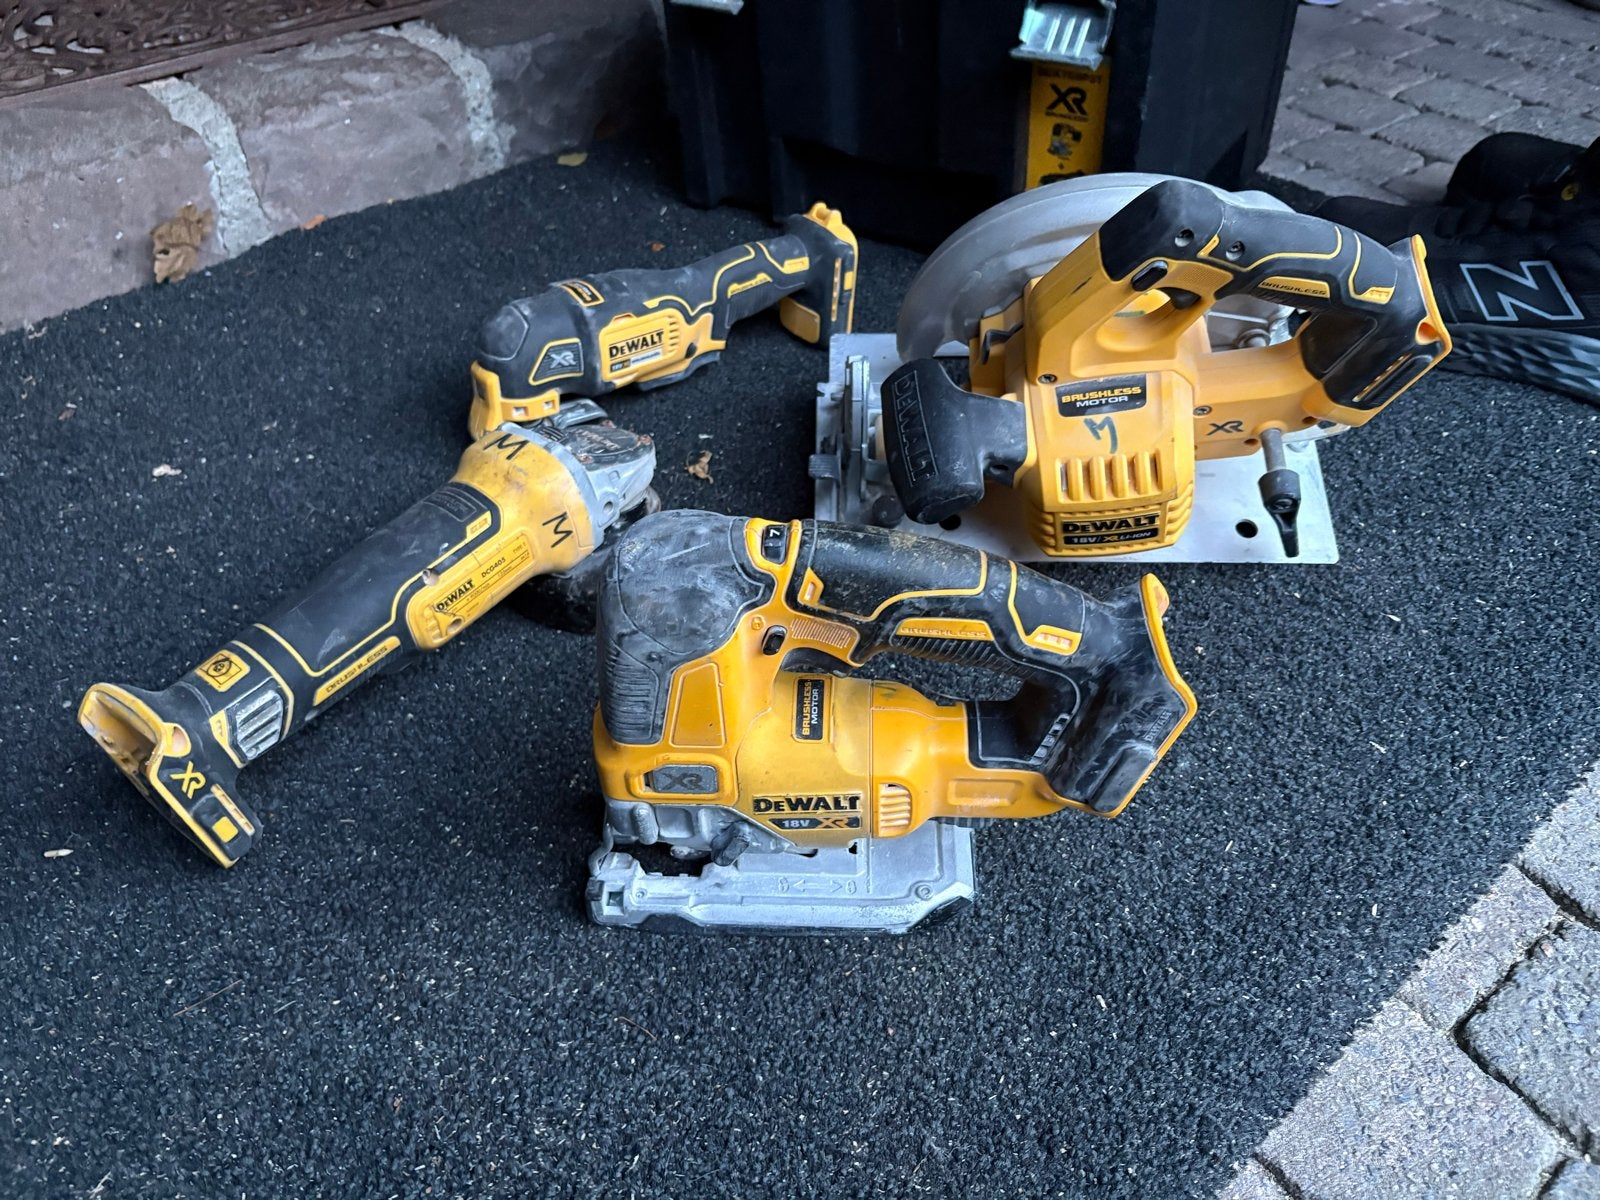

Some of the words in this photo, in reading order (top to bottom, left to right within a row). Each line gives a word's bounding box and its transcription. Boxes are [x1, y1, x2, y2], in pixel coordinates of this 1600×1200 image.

[1046, 83, 1088, 115] XR
[1261, 281, 1327, 296] BRUSHLESS
[1459, 260, 1585, 321] N
[550, 351, 576, 368] XR
[1061, 386, 1142, 403] BRUSHLESS
[1076, 396, 1129, 408] MOTOR
[1083, 416, 1118, 454] M
[1206, 420, 1245, 436] XR
[483, 433, 530, 460] M
[1101, 534, 1119, 543] XR
[481, 556, 507, 579] DCG405
[802, 680, 812, 736] BRUSHLESS
[811, 688, 819, 724] MOTOR
[170, 761, 206, 799] XR
[662, 772, 702, 791] XR
[782, 819, 811, 829] 18V
[815, 818, 848, 829] XR
